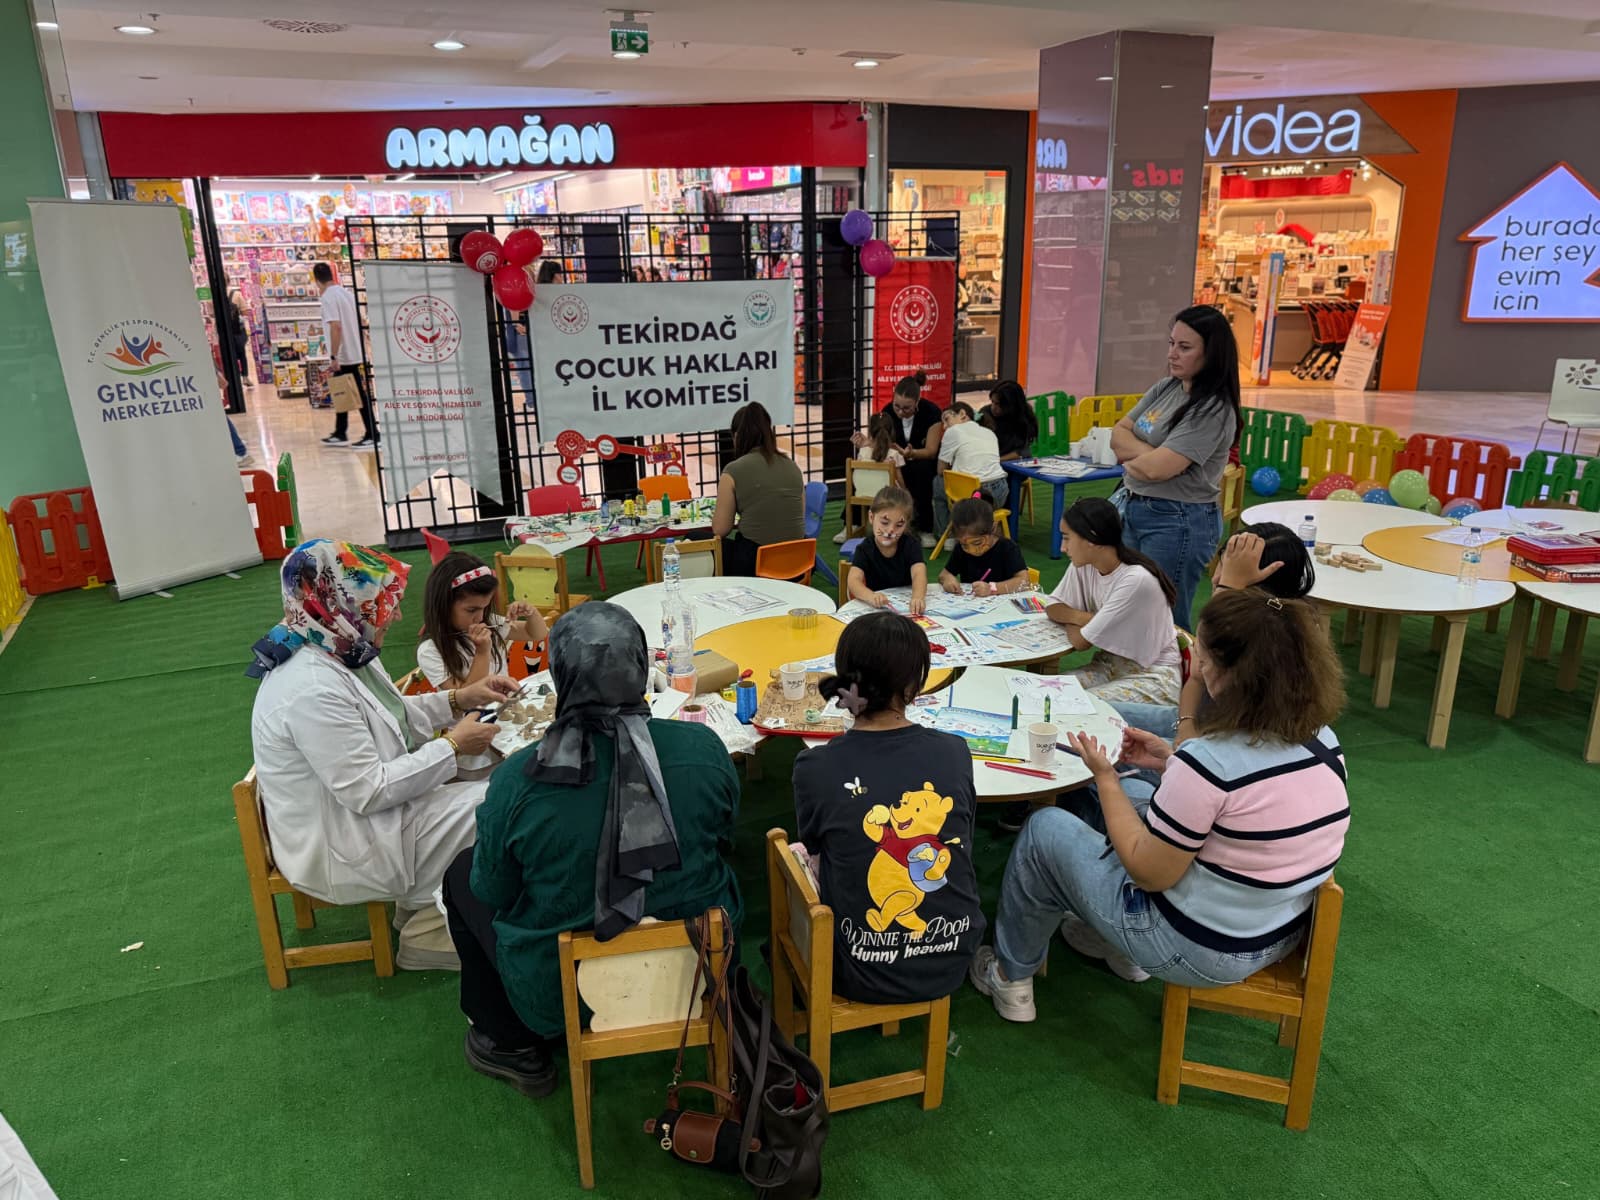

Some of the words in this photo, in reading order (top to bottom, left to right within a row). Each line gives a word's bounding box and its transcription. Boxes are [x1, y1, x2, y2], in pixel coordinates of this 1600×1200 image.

[386, 114, 614, 169] ARMAĞAN
[1205, 103, 1361, 157] videa
[1501, 241, 1546, 262] her
[1553, 244, 1596, 266] şey
[1497, 268, 1561, 286] evim
[1493, 291, 1539, 313] için
[598, 314, 737, 345] TEKİRDAĞ
[555, 356, 656, 387] ÇOCUK
[664, 350, 778, 375] HAKLARI
[97, 375, 198, 404] GENÇLİK
[592, 385, 617, 412] İL
[625, 377, 749, 410] KOMİTESİ
[102, 395, 204, 423] MERKEZLERİ
[412, 401, 441, 409] SOSYAL
[851, 945, 899, 964] Hunny
[903, 935, 959, 959] heaven!
